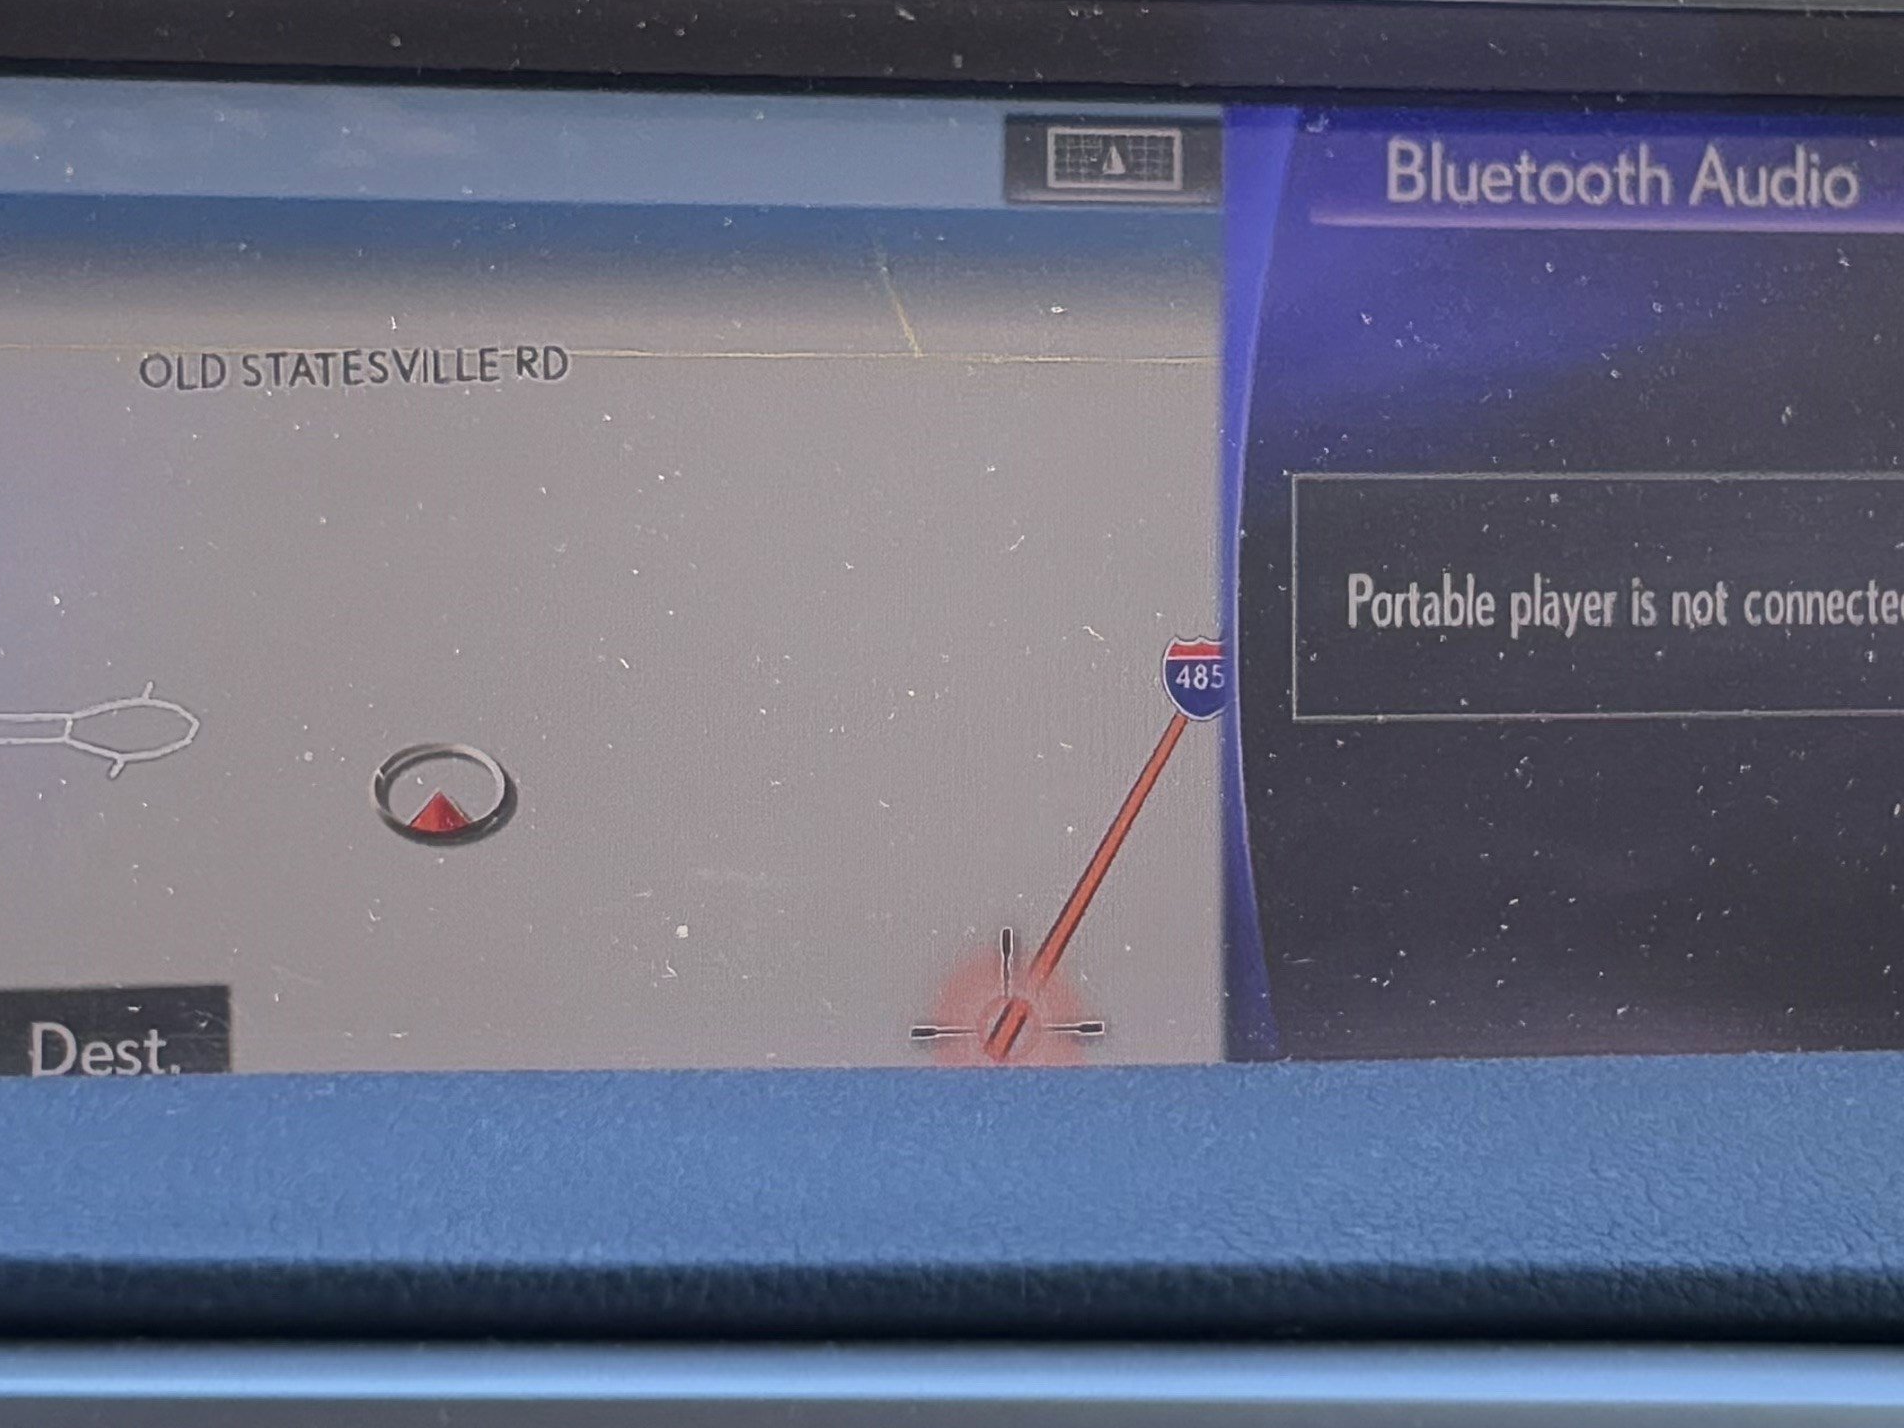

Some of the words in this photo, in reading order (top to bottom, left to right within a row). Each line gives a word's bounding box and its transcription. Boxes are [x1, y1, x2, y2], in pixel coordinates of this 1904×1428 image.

[1386, 136, 1672, 207] Bluetooth
[1690, 143, 1860, 210] Audio
[139, 351, 227, 391] OLD
[242, 347, 501, 389] STATESVILLE
[516, 345, 569, 381] RD
[1348, 572, 1496, 628] Portable
[1510, 572, 1618, 640] player
[1632, 576, 1658, 627] is
[1672, 580, 1729, 627] not
[1175, 663, 1225, 690] 485
[31, 1021, 181, 1079] Dest.
